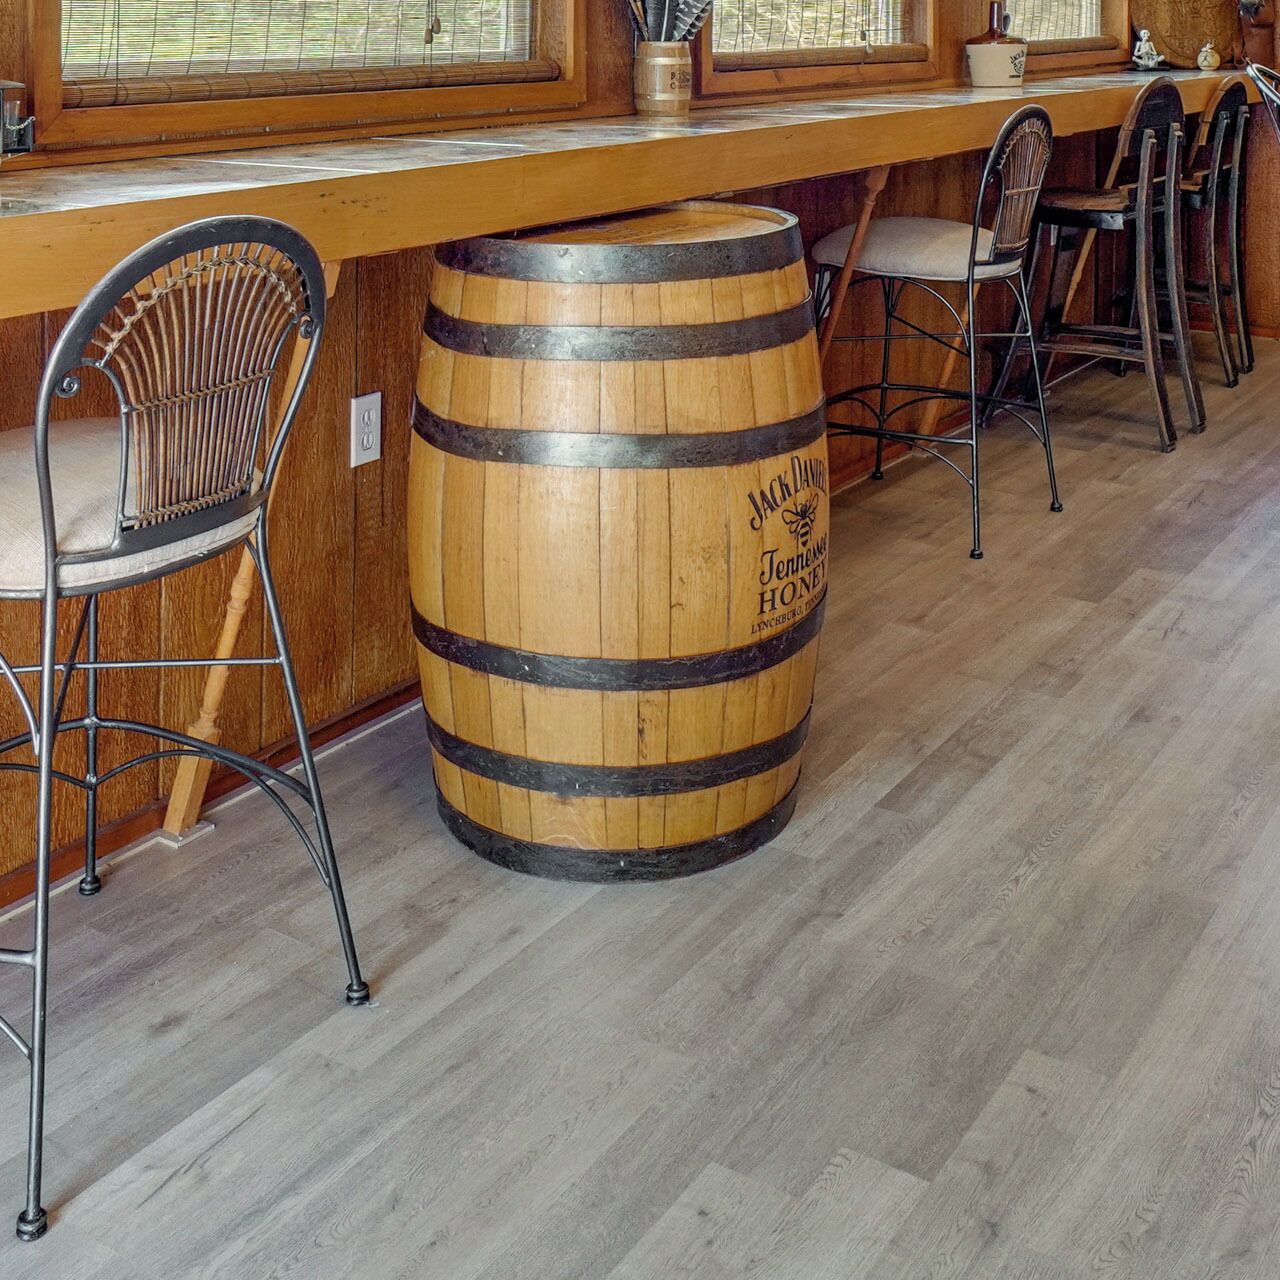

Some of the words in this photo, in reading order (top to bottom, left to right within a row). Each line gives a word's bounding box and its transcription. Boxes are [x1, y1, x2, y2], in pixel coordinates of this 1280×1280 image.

[747, 471, 793, 531] JACK
[759, 531, 827, 586] Tennessee
[757, 558, 827, 616] HONEY
[751, 605, 803, 635] LYNCHBURG,
